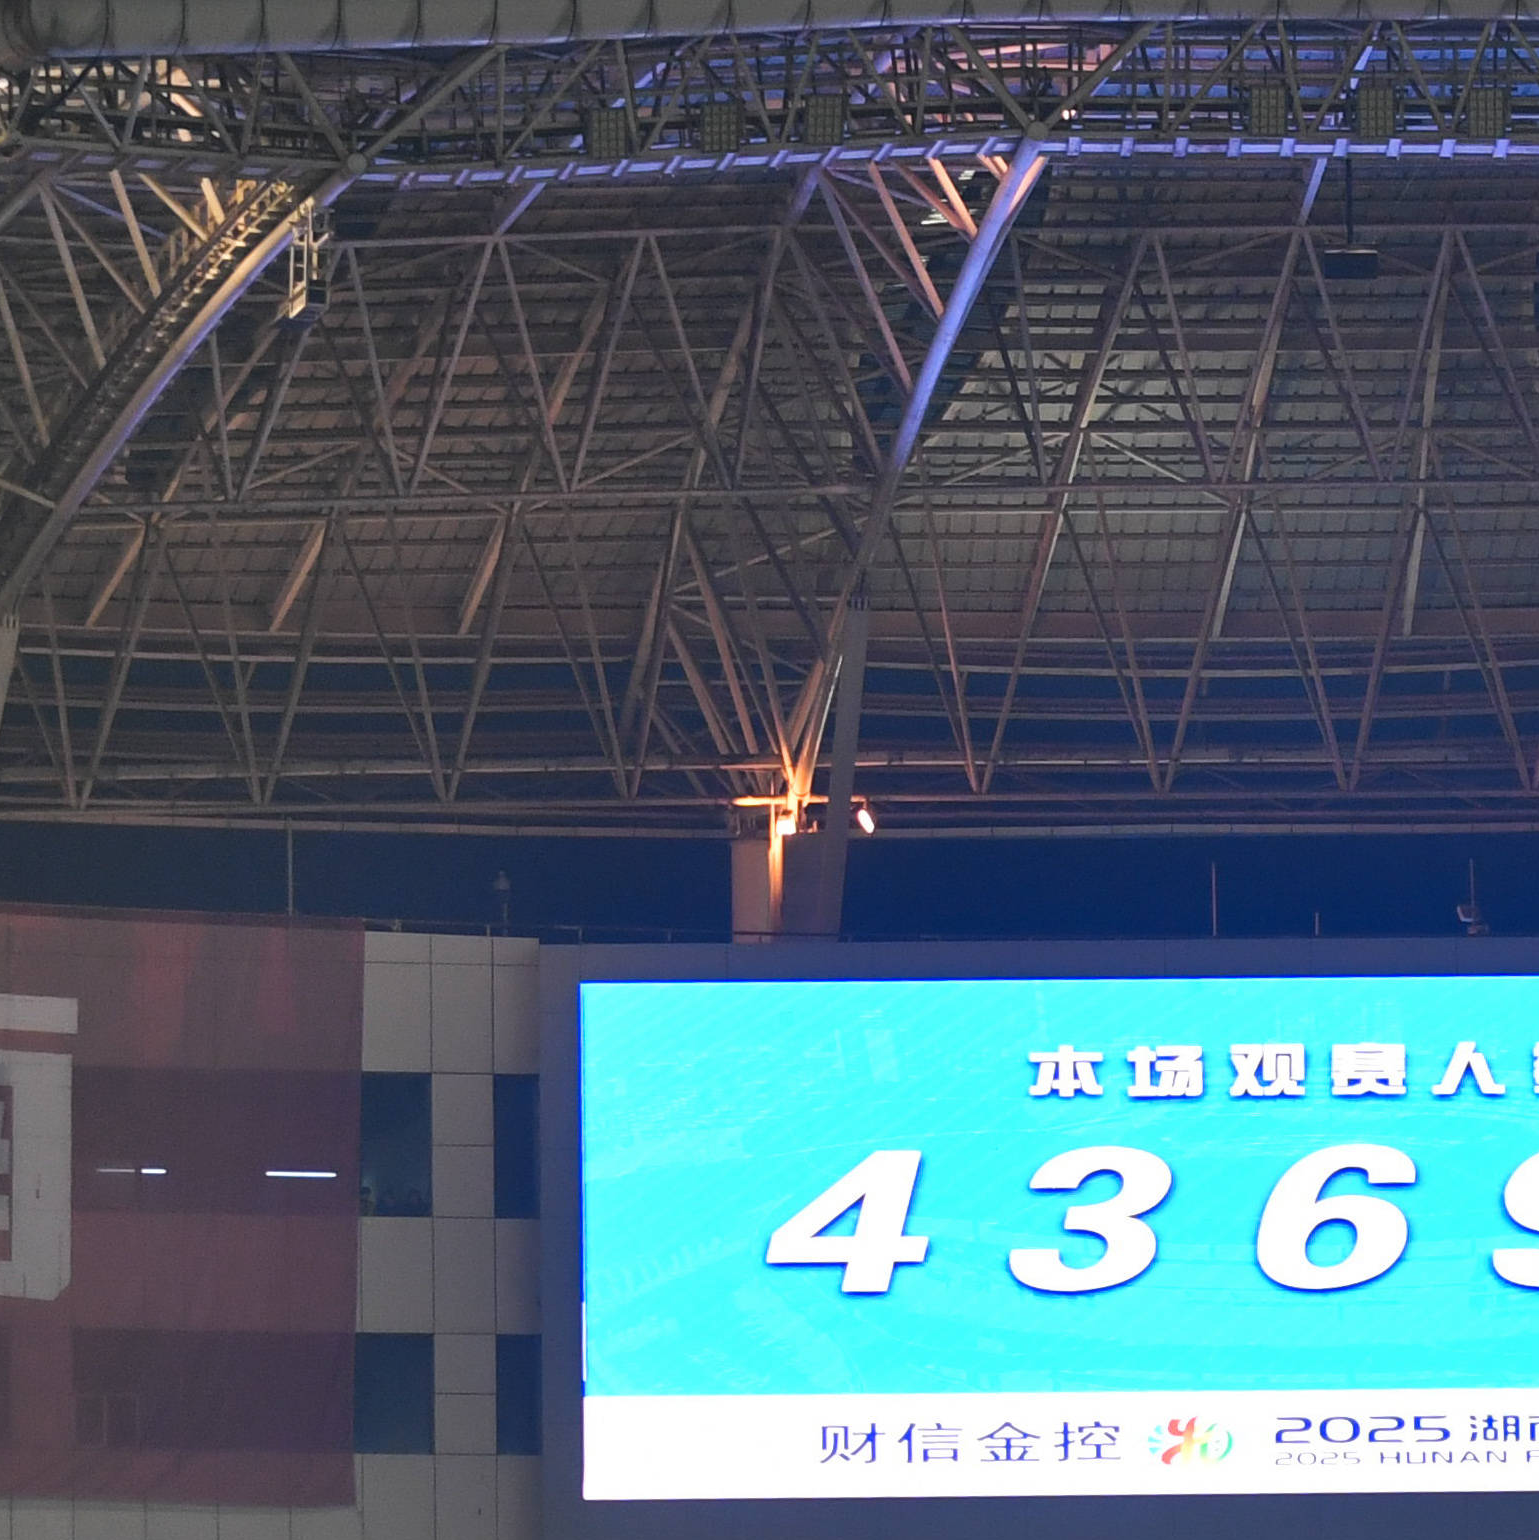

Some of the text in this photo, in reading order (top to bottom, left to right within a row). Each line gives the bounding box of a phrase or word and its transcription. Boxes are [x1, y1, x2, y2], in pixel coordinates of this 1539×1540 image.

[820, 1420, 1122, 1463] 财信金控
[1275, 1414, 1451, 1444] 2025
[1275, 1451, 1362, 1466] 2025
[1379, 1449, 1509, 1465] HUNAN
